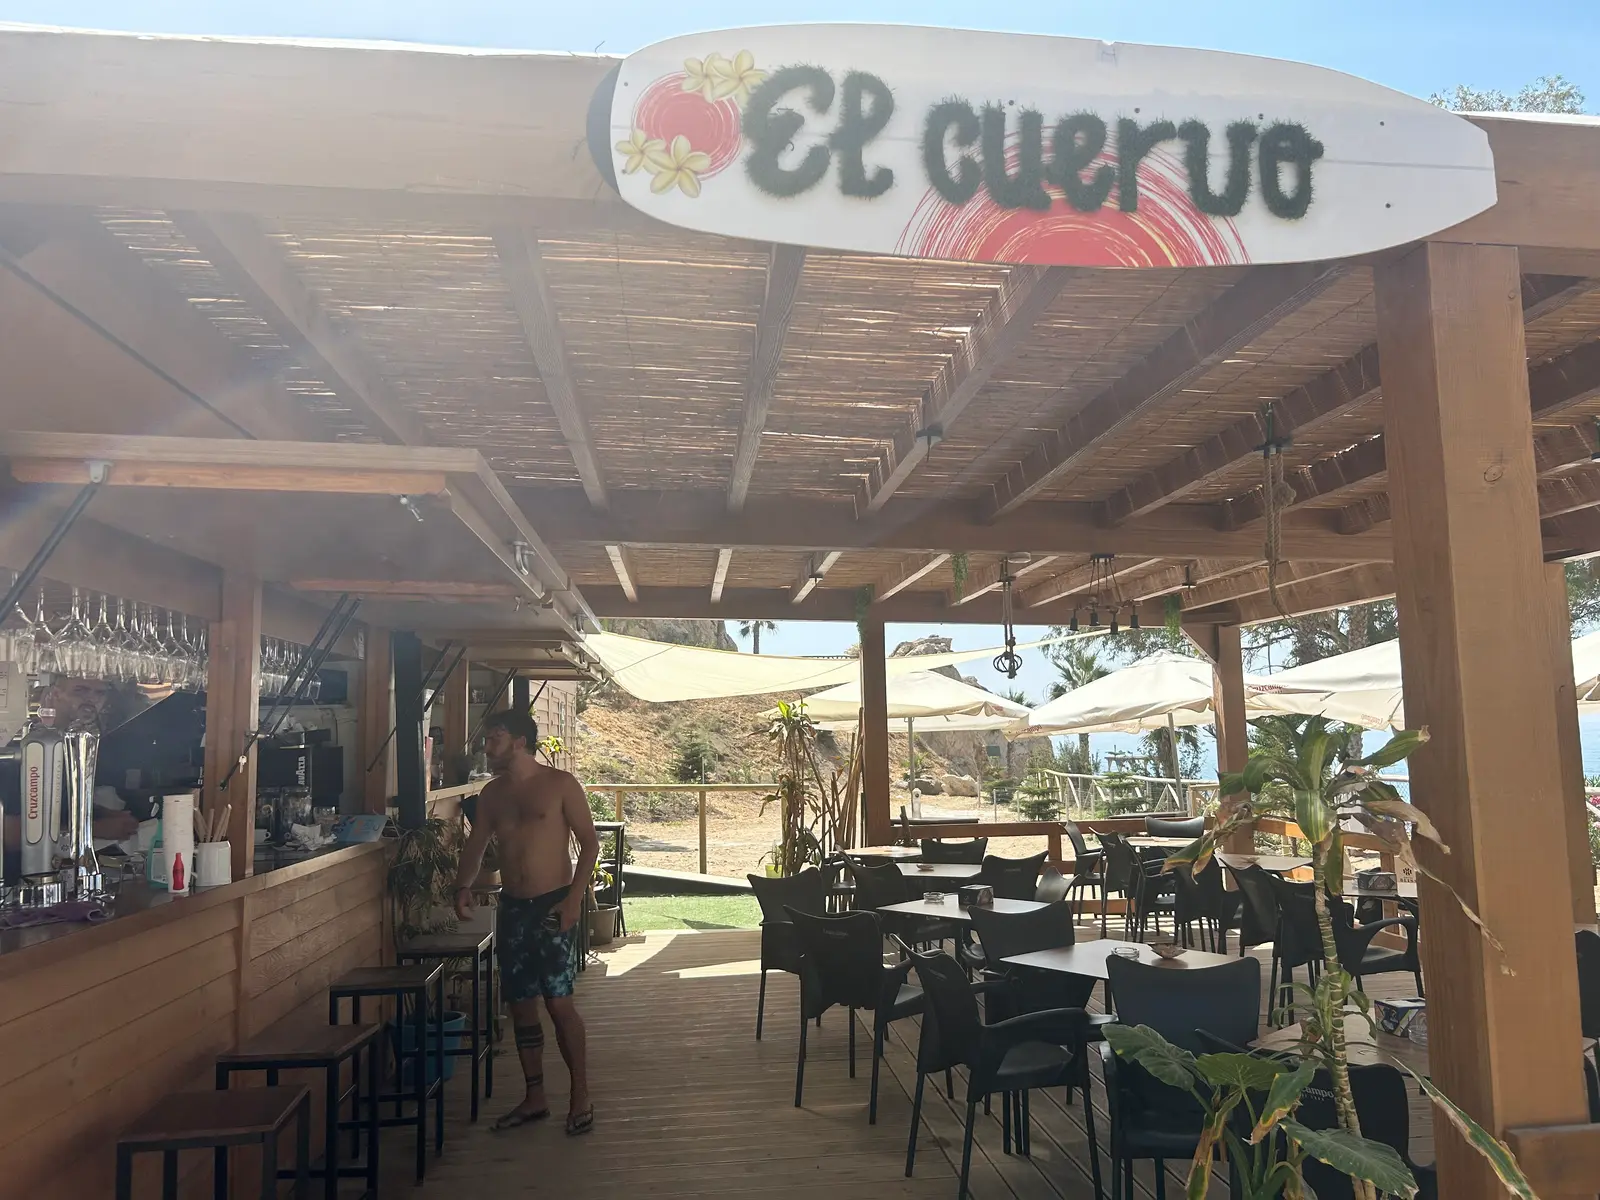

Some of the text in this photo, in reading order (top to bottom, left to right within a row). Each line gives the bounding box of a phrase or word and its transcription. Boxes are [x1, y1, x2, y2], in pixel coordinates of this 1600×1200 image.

[743, 63, 1325, 220] El cuervo
[295, 756, 306, 785] AVAZZA
[28, 766, 41, 820] Cruzcampo
[1302, 1086, 1334, 1098] campo
